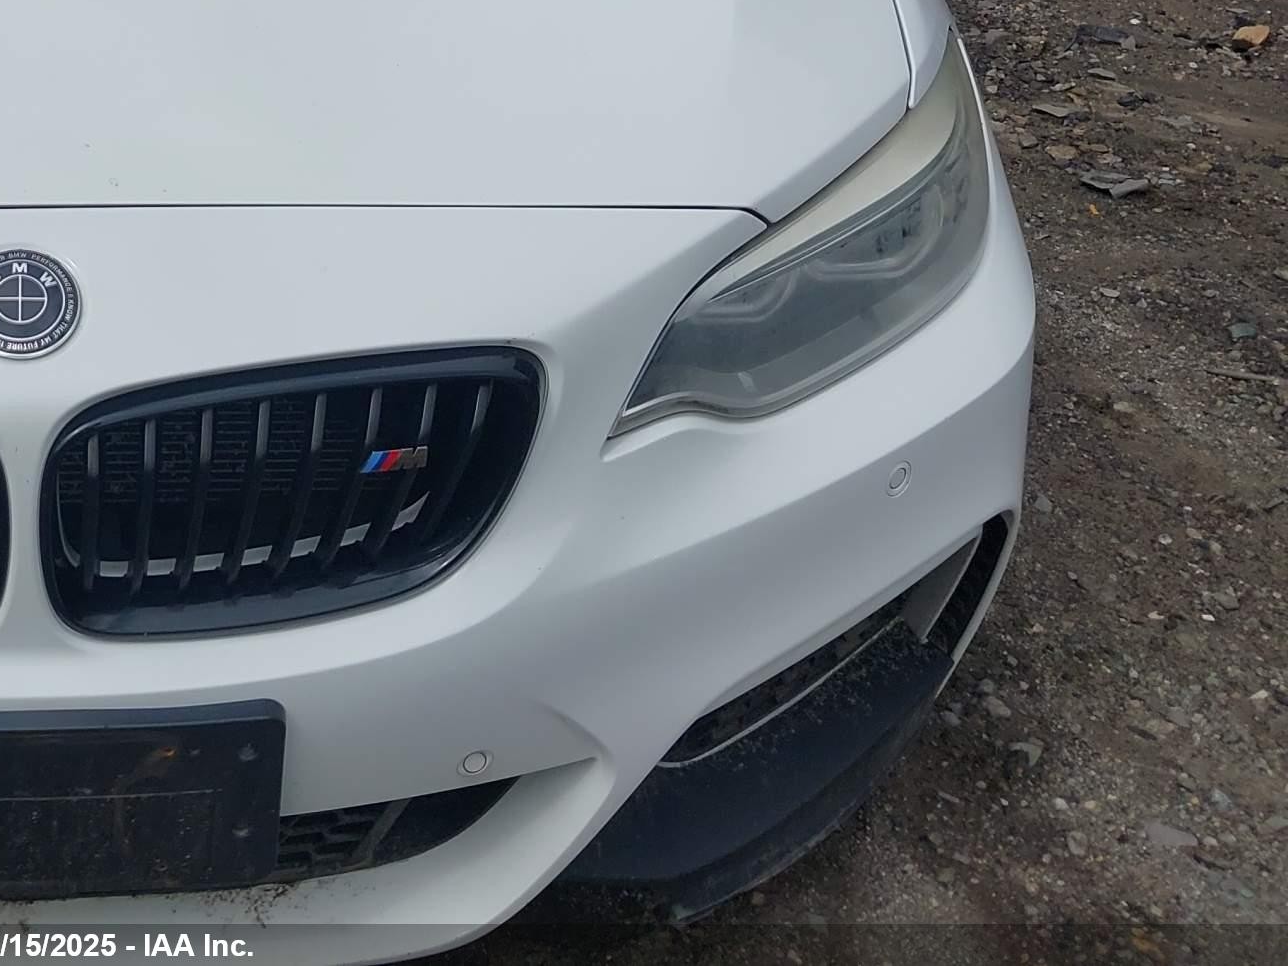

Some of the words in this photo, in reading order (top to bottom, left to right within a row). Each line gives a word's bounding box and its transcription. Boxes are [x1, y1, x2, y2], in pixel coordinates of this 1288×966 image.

[66, 298, 75, 321] KNOW
[52, 322, 68, 339] THAT
[6, 341, 39, 351] FUTURE
